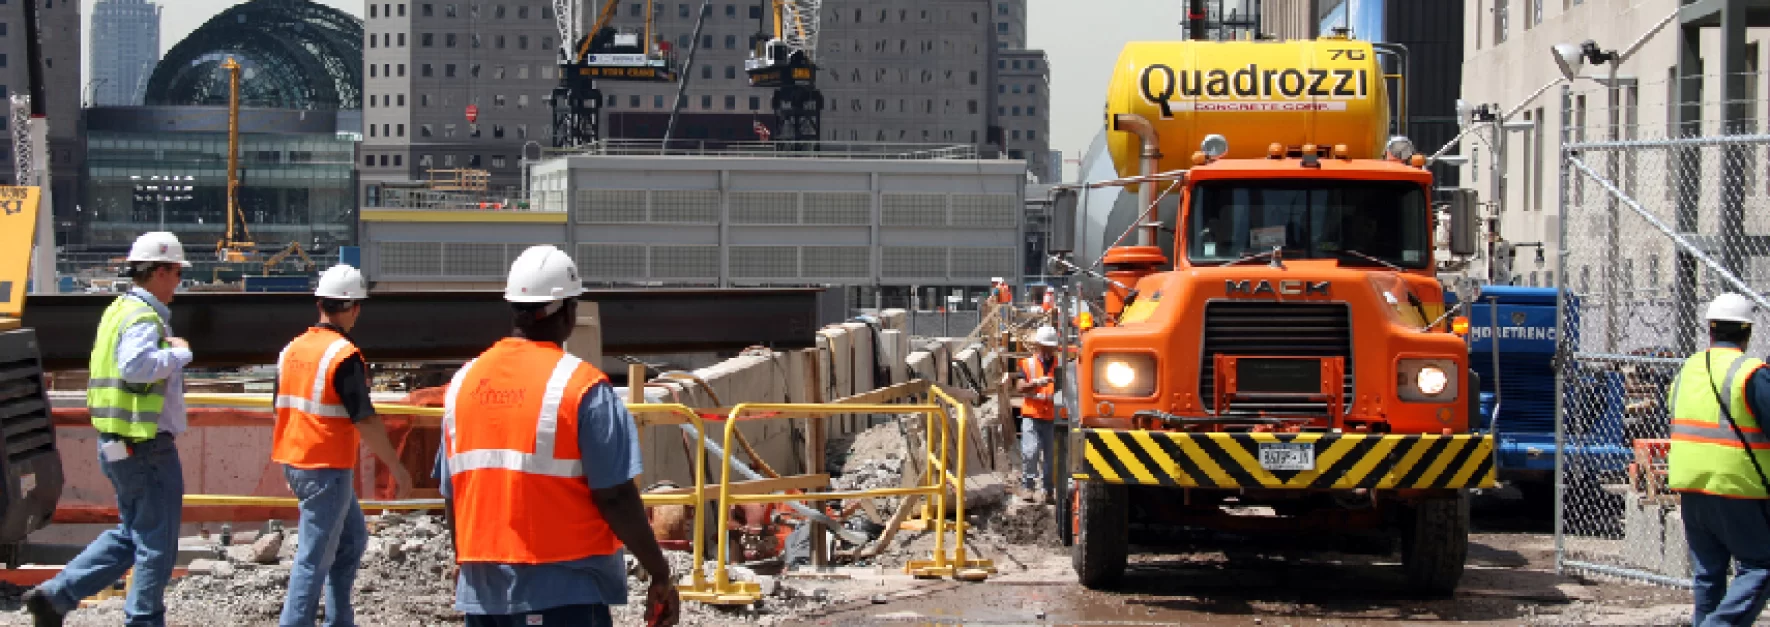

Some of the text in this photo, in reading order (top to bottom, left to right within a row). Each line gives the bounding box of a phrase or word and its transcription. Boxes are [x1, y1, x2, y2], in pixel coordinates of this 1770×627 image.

[1326, 49, 1366, 60] 76
[1139, 63, 1367, 117] Quadrozzi
[1194, 102, 1279, 111] CONCRETE
[1225, 279, 1332, 296] MACK
